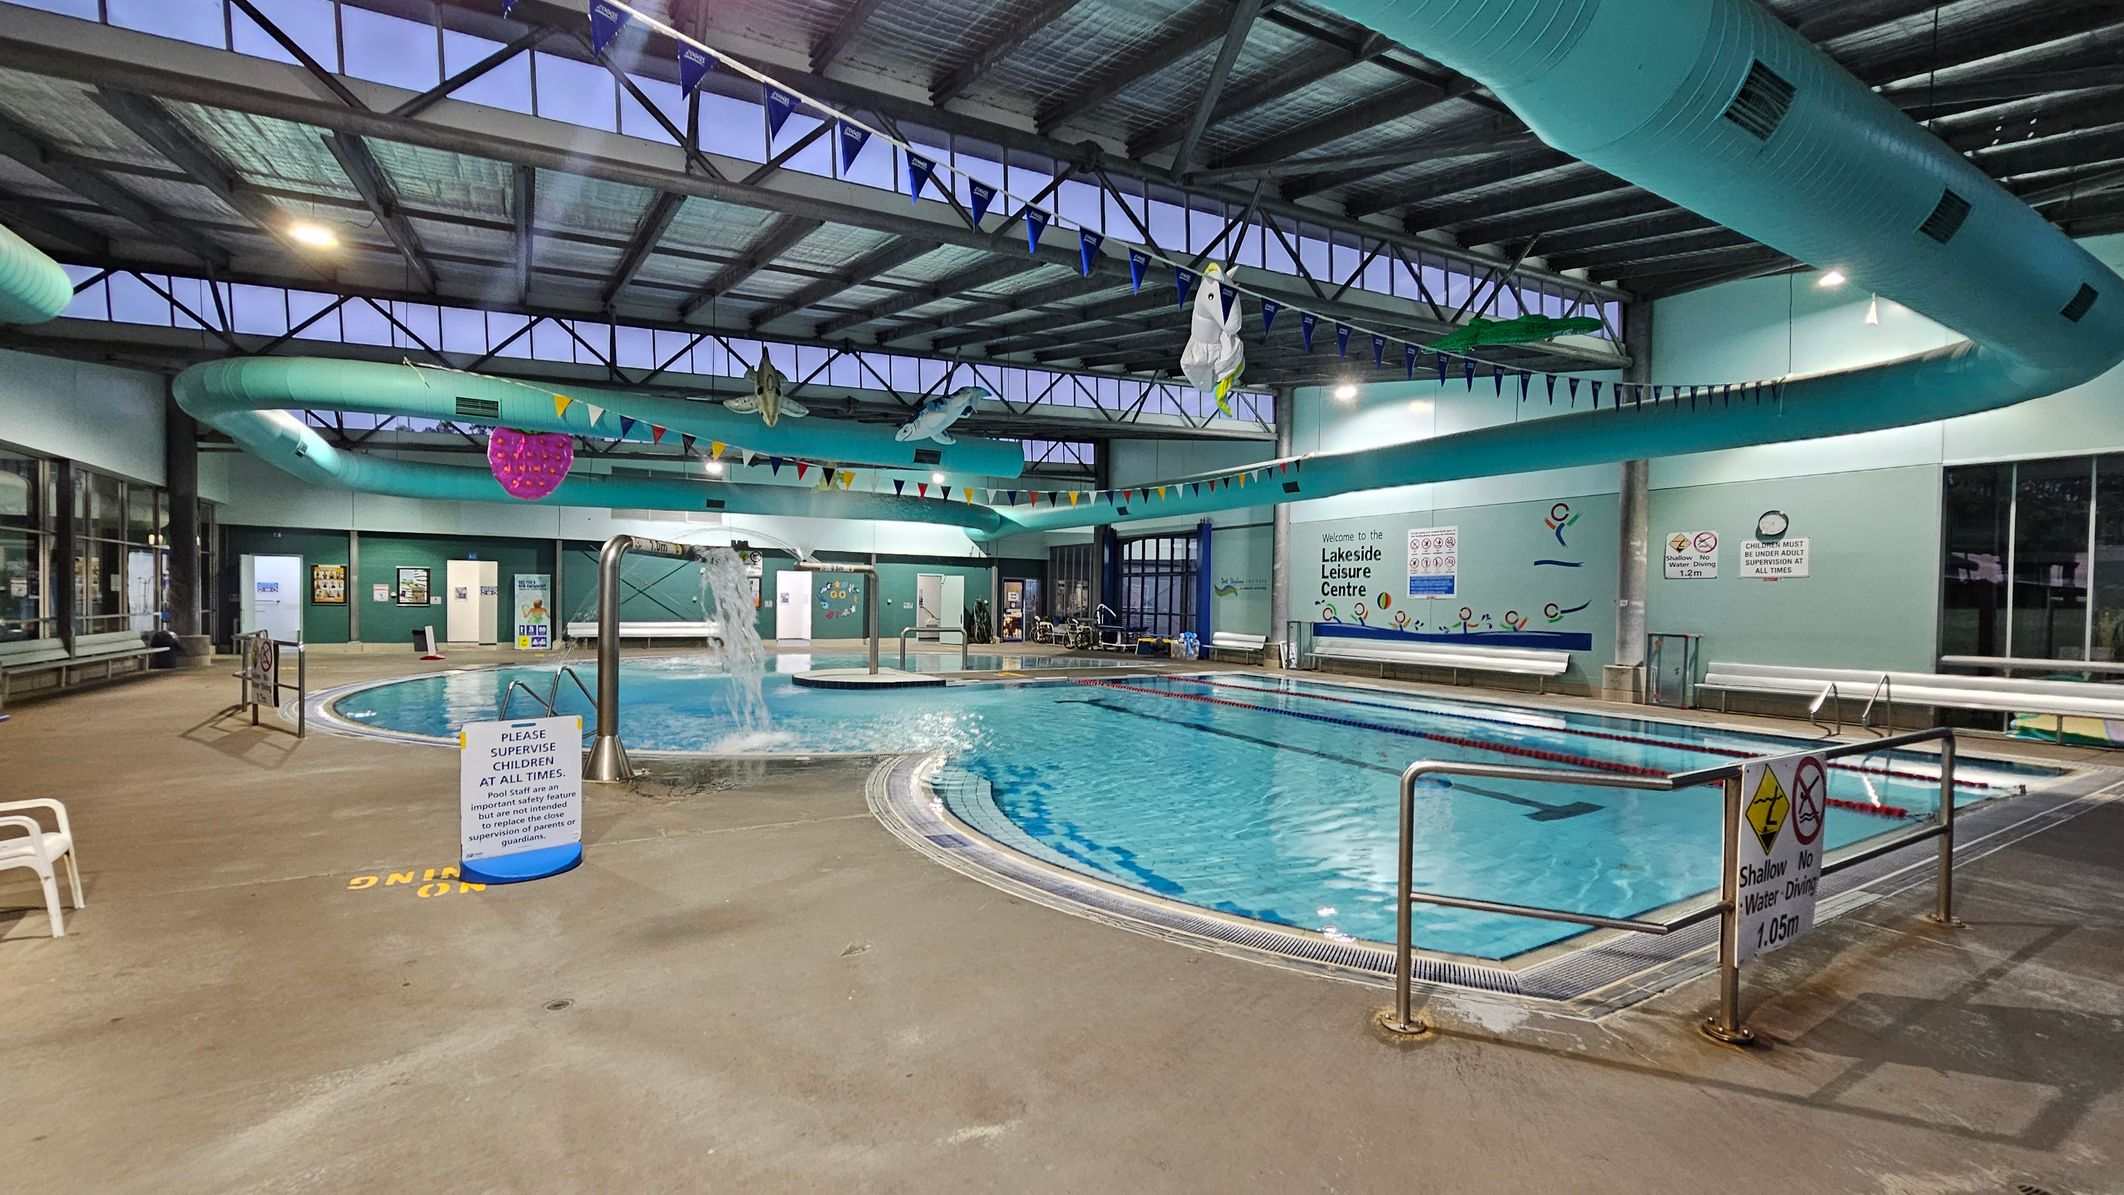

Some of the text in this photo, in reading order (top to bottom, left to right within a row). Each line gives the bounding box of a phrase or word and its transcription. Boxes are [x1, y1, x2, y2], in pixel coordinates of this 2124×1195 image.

[1322, 529, 1383, 543] Welcome to the
[1745, 541, 1780, 549] CHILDREN
[1321, 545, 1382, 563] Lakeside
[1745, 558, 1792, 566] SUPERVISION
[1321, 564, 1371, 579] Leisure
[1680, 569, 1702, 577] 1.2m
[1321, 581, 1366, 597] Centre
[501, 729, 546, 742] PLEASE
[490, 742, 556, 757] SUPERVISE
[493, 756, 554, 771] CHILDREN
[479, 768, 566, 787] AT ALL TIMES.
[487, 791, 507, 799] Pool
[510, 786, 531, 796] Staff
[532, 785, 546, 793] are
[470, 791, 577, 812] important safety feature
[478, 801, 568, 820] but are not intended
[481, 810, 565, 830] to replace the close
[468, 818, 576, 842] supervision of parents or
[501, 833, 547, 847] guardians.
[1798, 850, 1814, 871] No
[1739, 858, 1788, 888] Shallow
[1744, 875, 1818, 916] Water Diving
[1757, 913, 1800, 949] 1.05m
